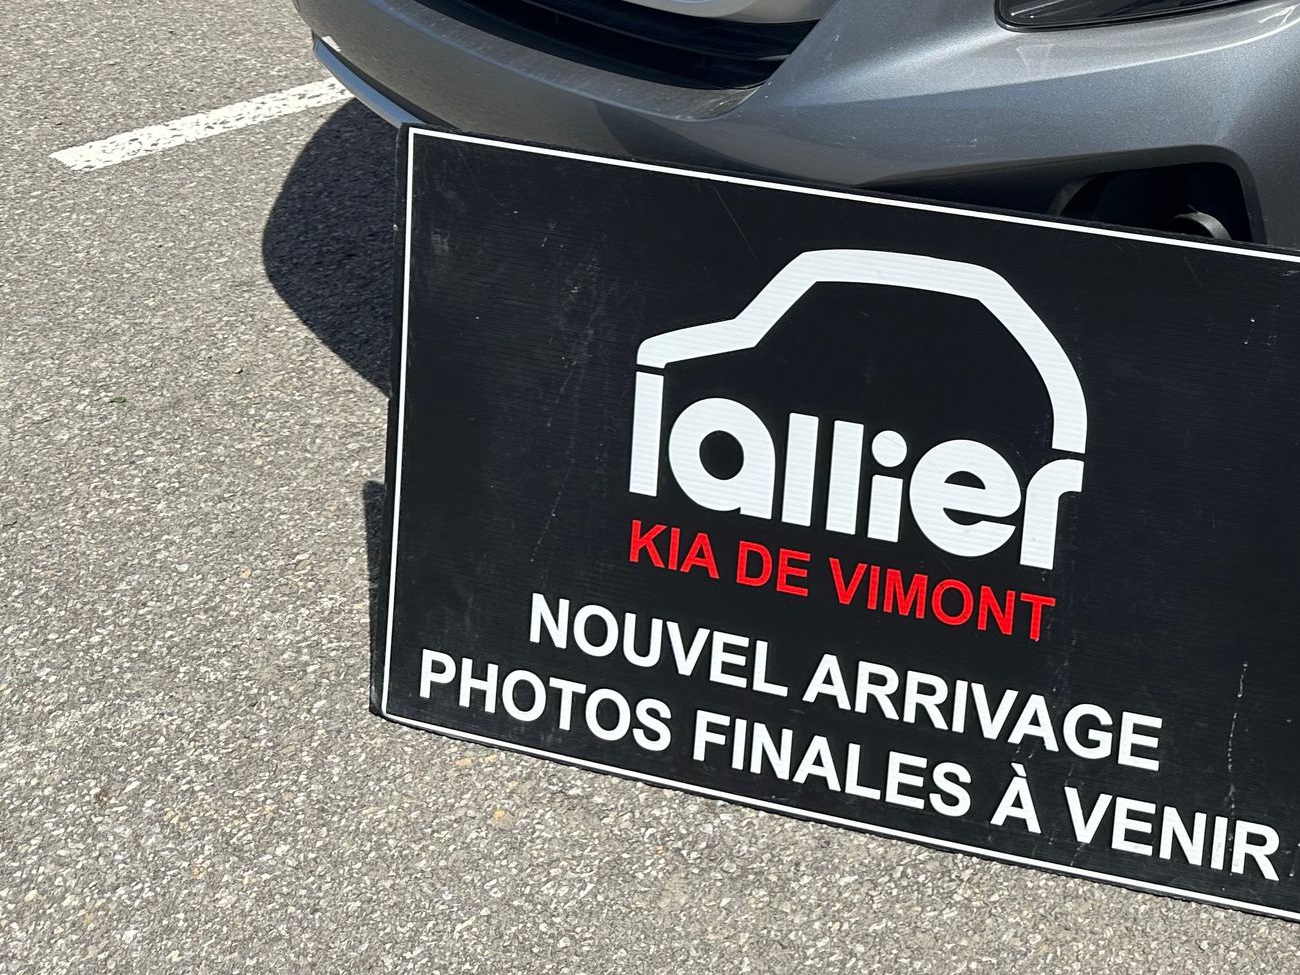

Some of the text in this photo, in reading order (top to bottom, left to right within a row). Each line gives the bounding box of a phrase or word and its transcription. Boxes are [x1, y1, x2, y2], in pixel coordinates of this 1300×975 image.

[629, 519, 1057, 641] KIA DE VIMONT
[419, 648, 1280, 882] PHOTOS FINALES À VENIR
[529, 592, 1163, 772] NOUVEL ARRIVAGE
